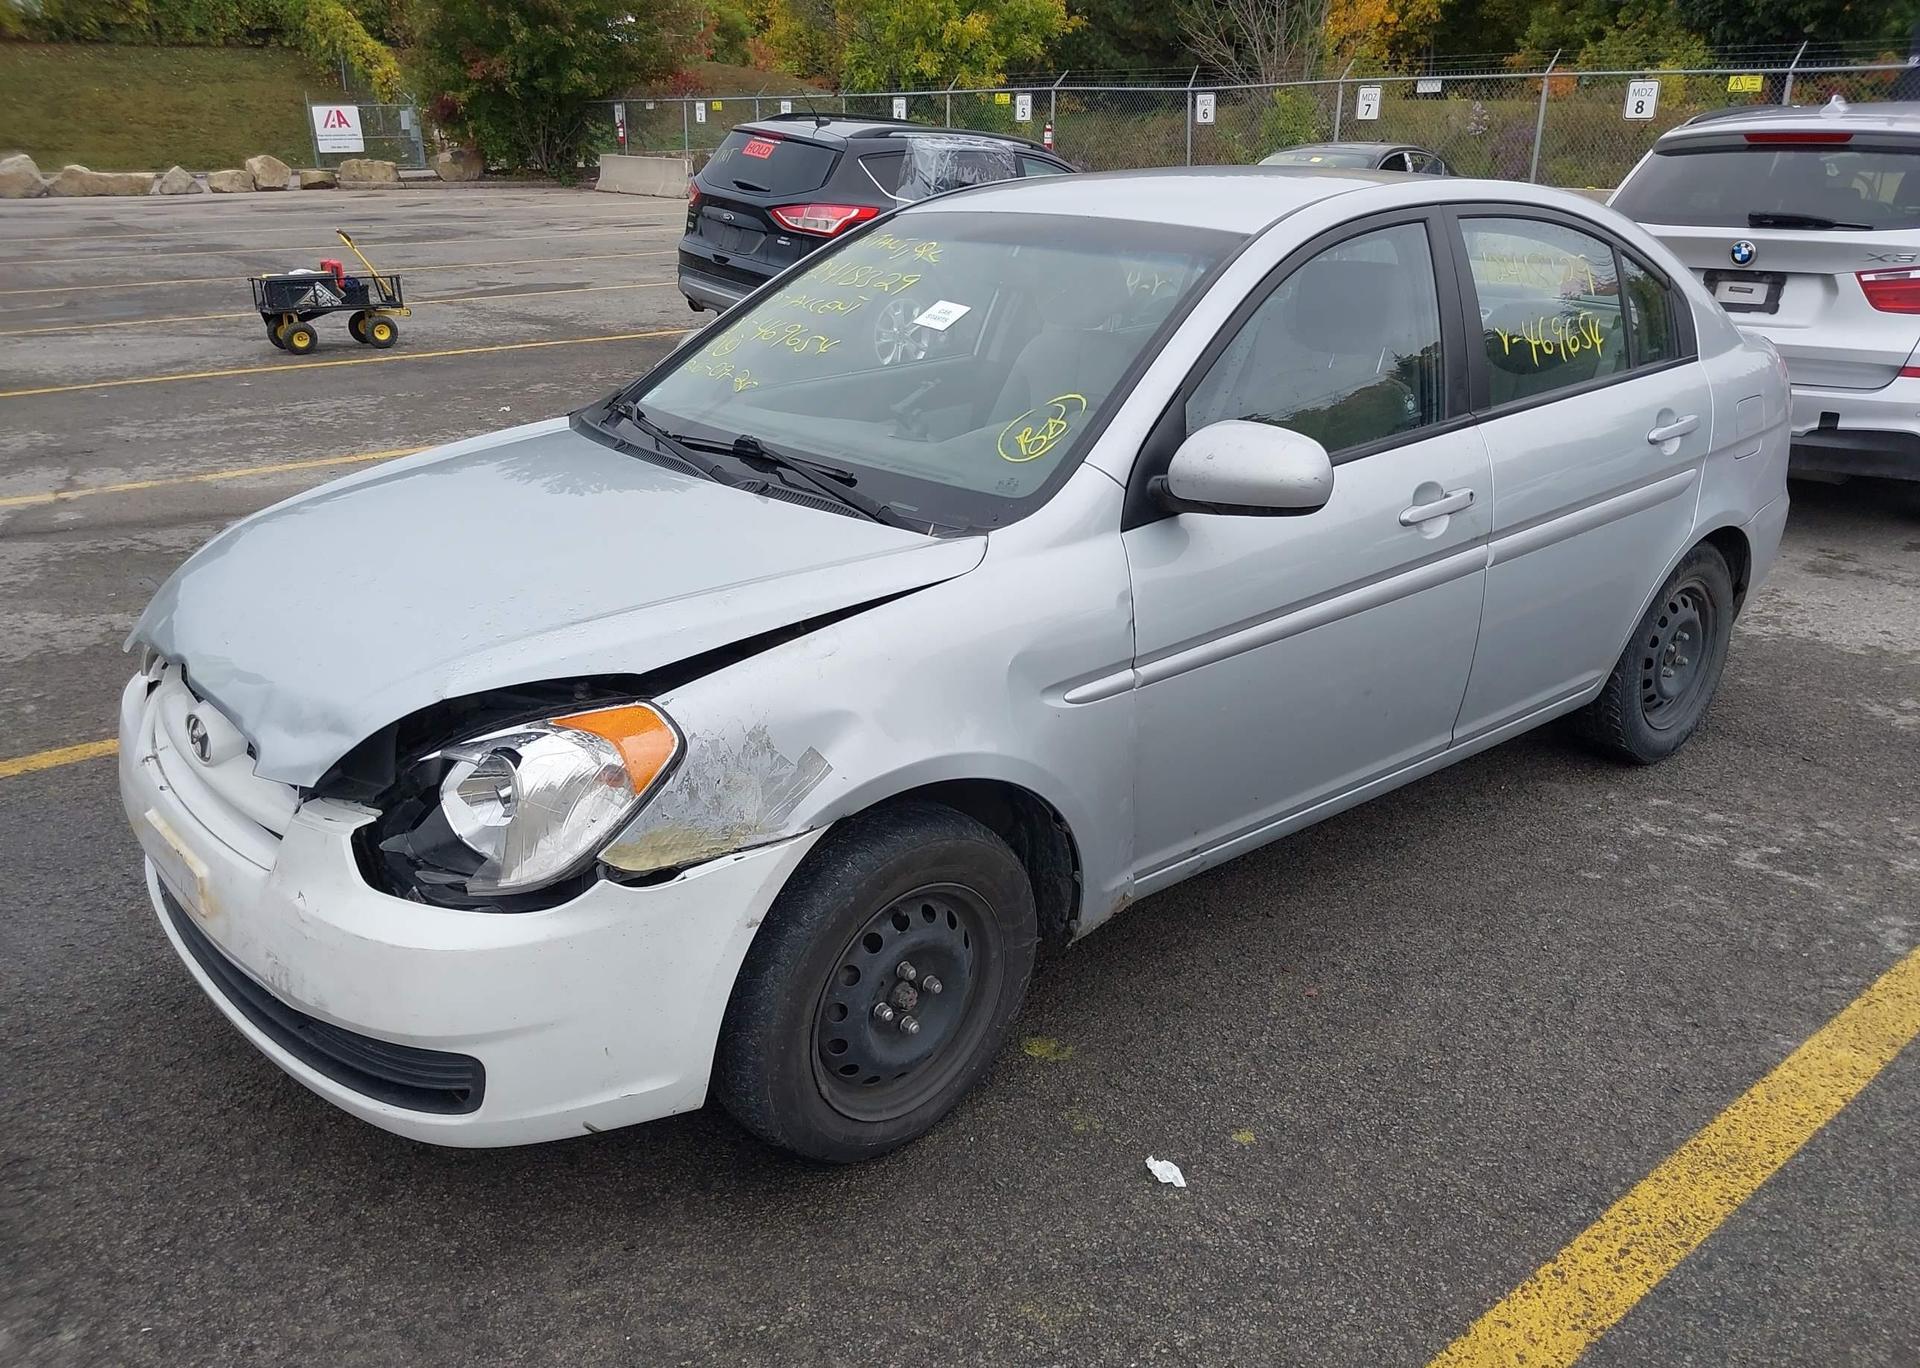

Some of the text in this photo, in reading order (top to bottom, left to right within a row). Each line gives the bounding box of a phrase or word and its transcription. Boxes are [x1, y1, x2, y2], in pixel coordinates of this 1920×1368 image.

[1361, 92, 1378, 102] MDZ
[1632, 87, 1654, 97] MDZ
[1020, 107, 1026, 118] 5
[1364, 103, 1372, 117] 7
[1634, 99, 1645, 114] 8
[1202, 107, 1209, 120] 6
[745, 142, 771, 155] HOLD
[1864, 252, 1918, 263] X3
